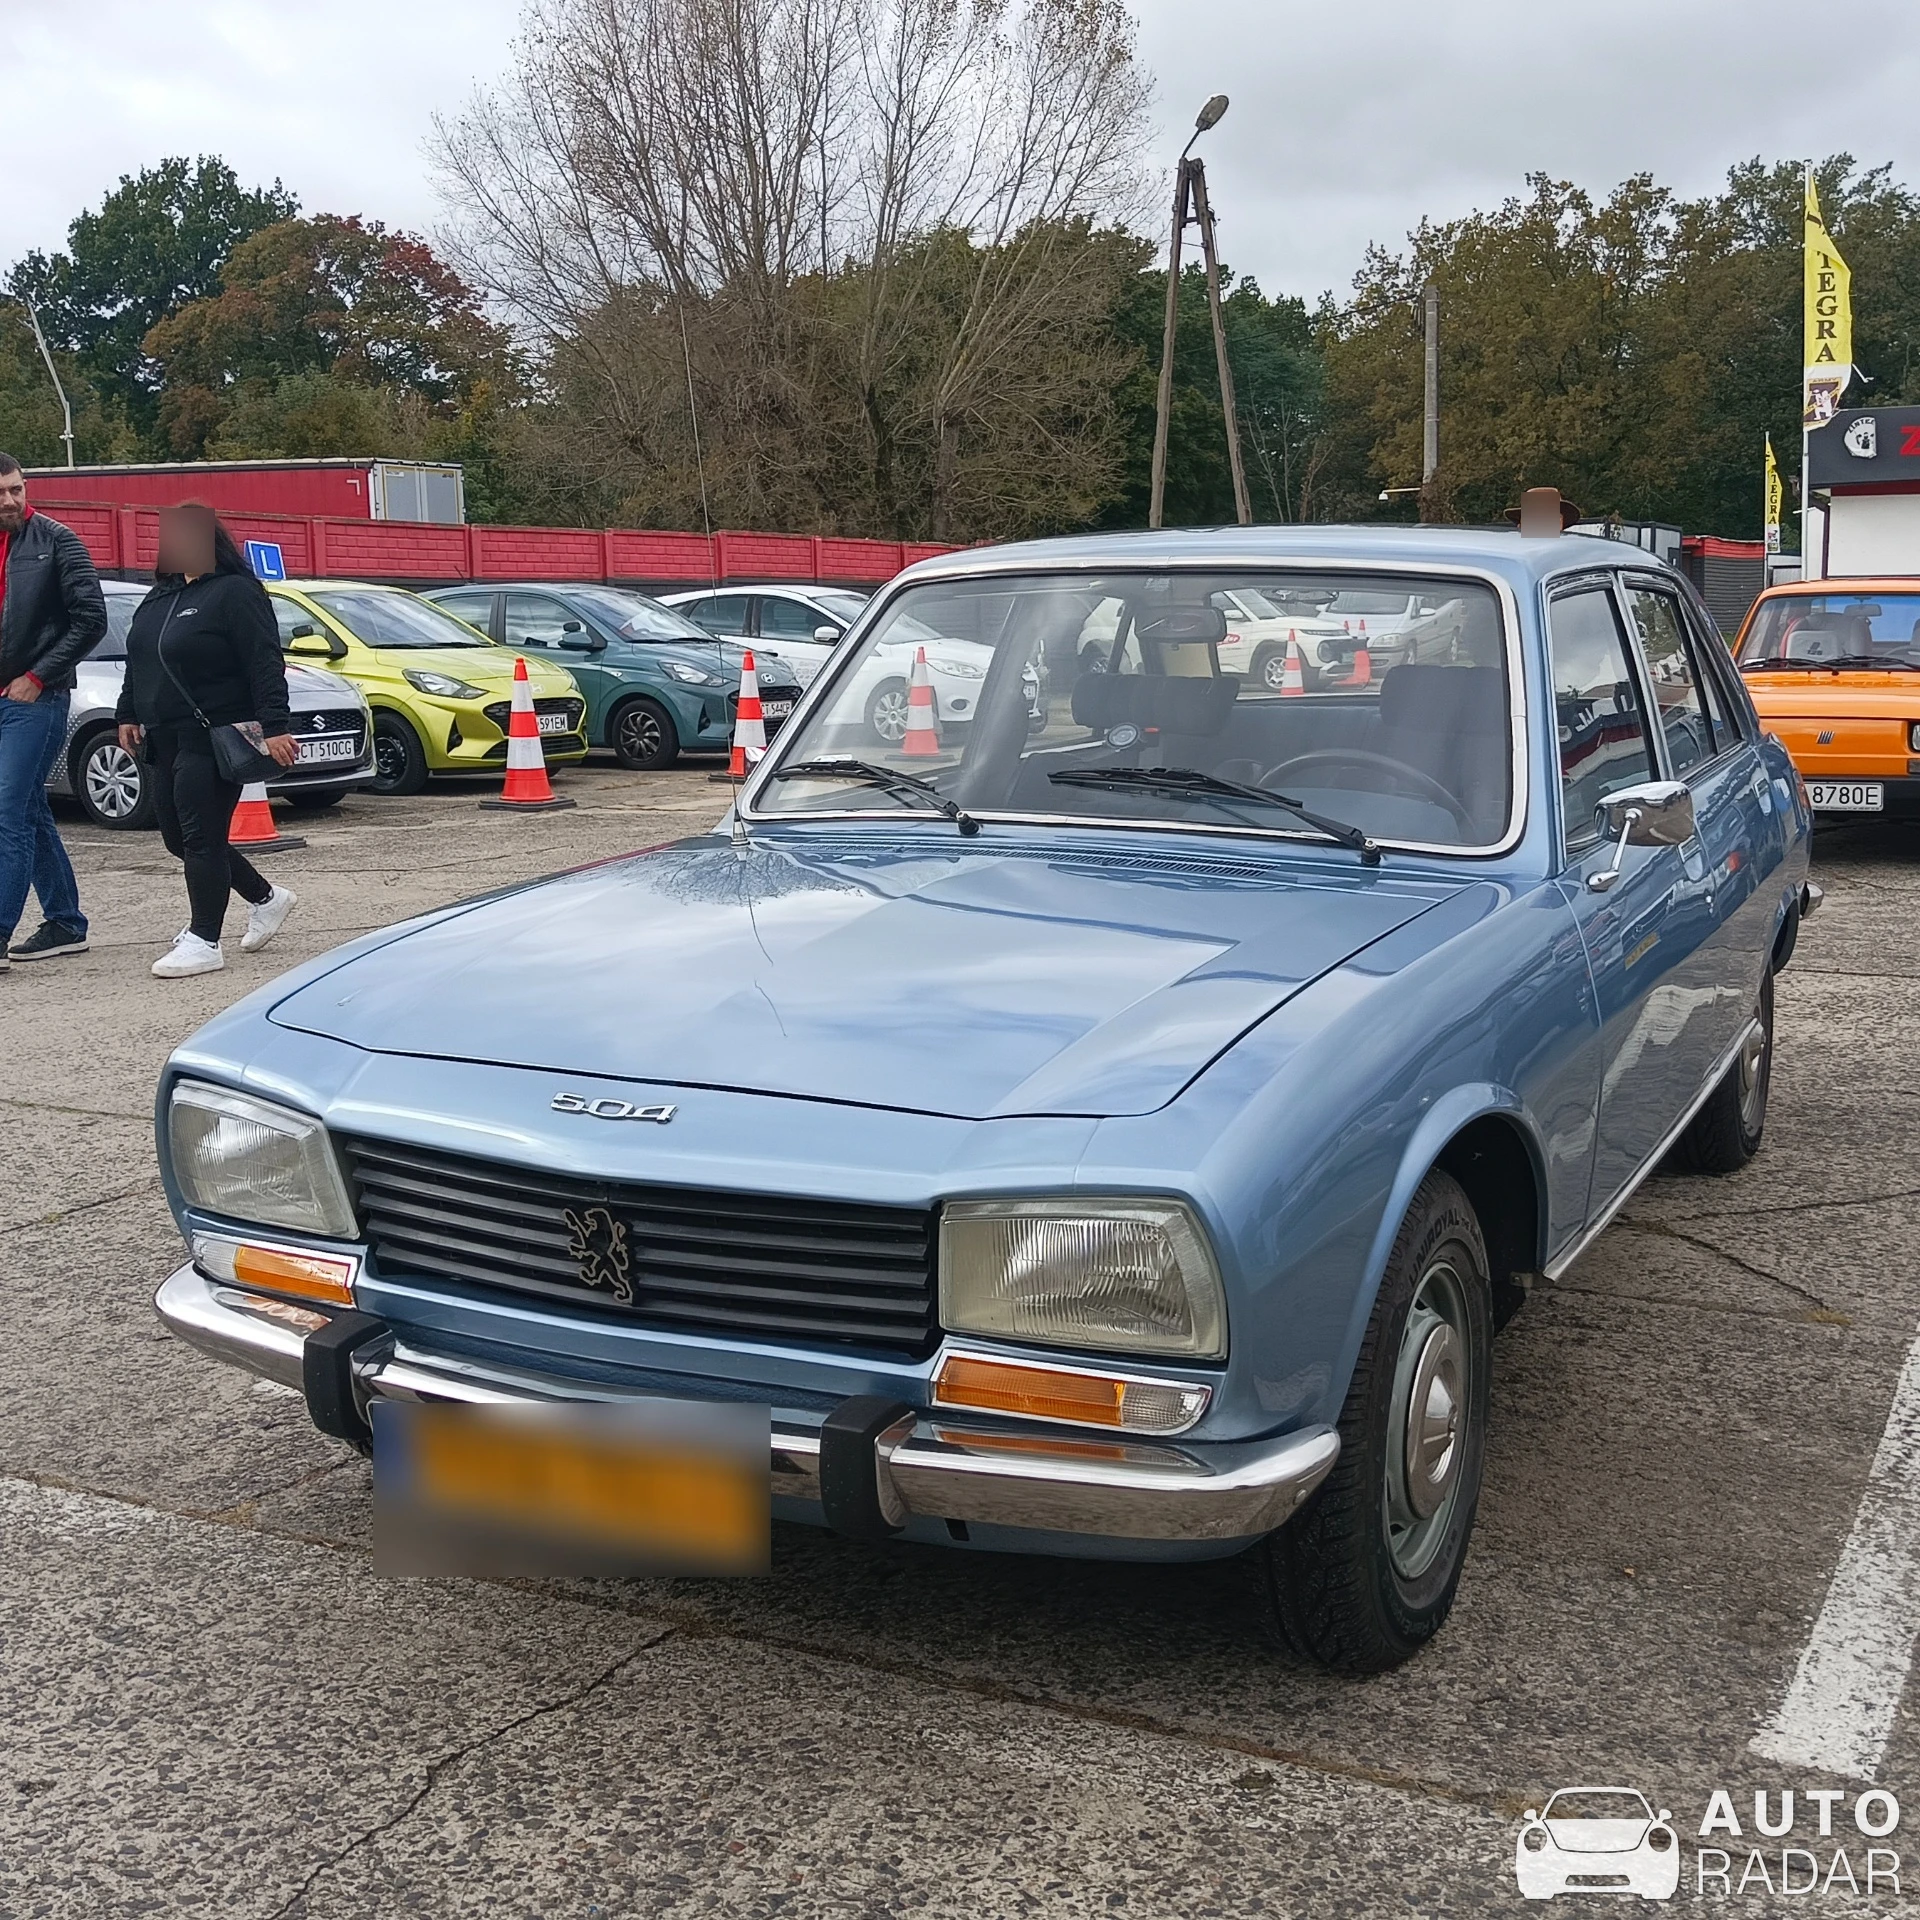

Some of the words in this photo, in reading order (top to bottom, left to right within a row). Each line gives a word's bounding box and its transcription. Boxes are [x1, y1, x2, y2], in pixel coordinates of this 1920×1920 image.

[260, 549, 278, 576] L
[300, 743, 315, 758] CT
[319, 740, 352, 757] 510CG
[1812, 786, 1878, 805] 8780E
[550, 1092, 678, 1124] 504
[1408, 1208, 1460, 1287] UNIROYAL
